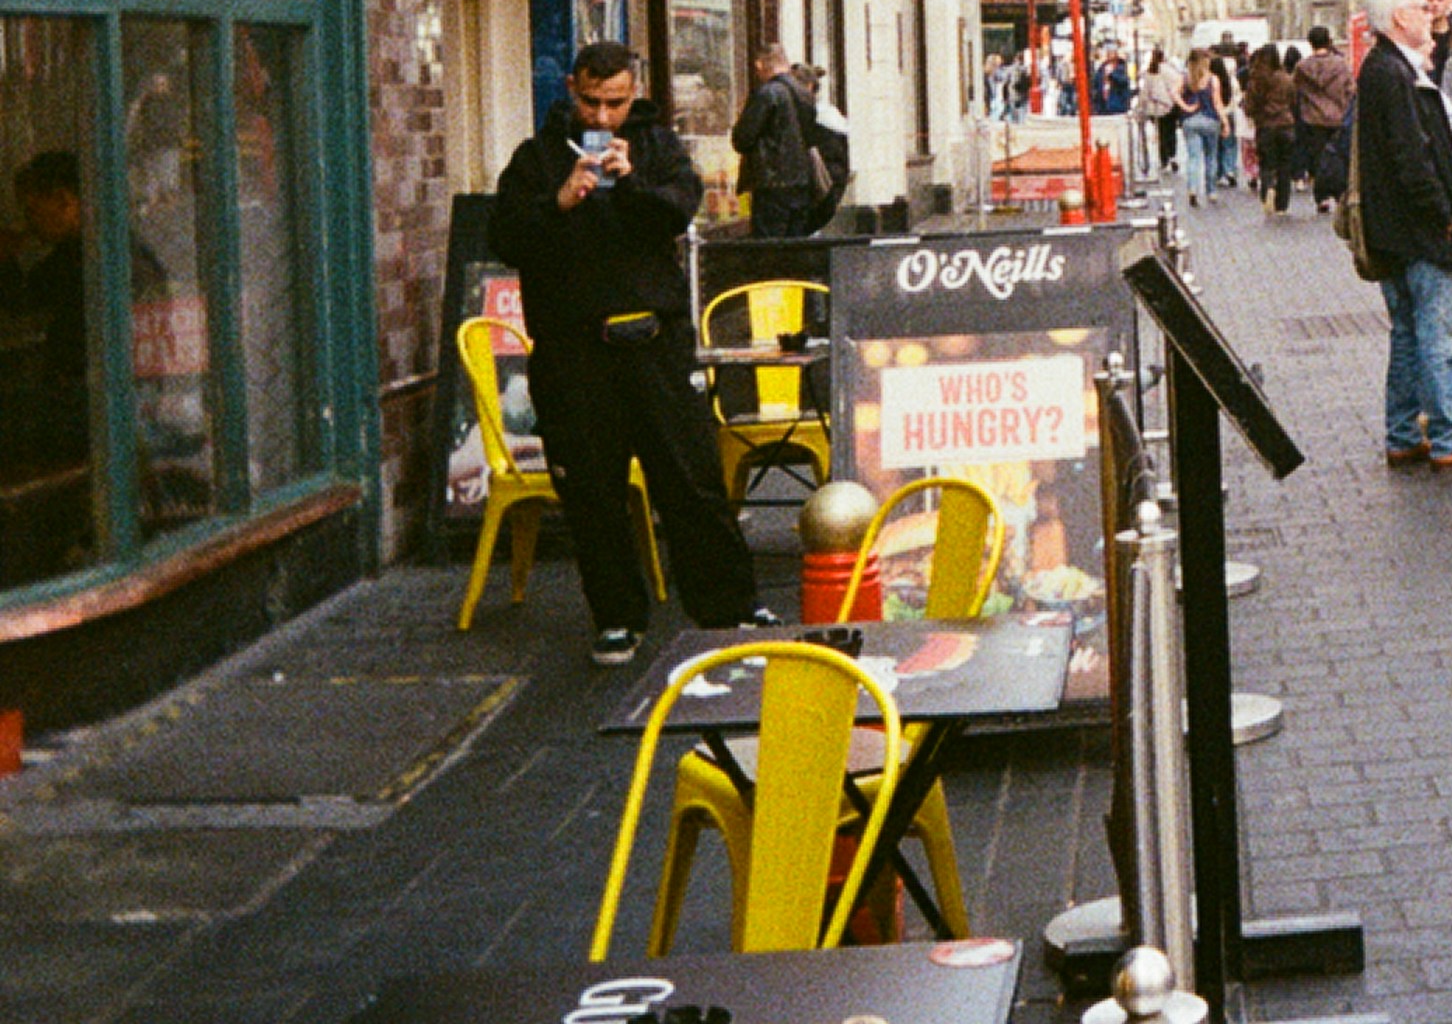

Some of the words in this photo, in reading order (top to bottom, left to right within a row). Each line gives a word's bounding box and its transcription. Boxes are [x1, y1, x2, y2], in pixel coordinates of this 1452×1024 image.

[896, 244, 1066, 300] O'Neills
[938, 371, 1028, 406] WHO'S
[903, 405, 1065, 452] HUNGRY?
